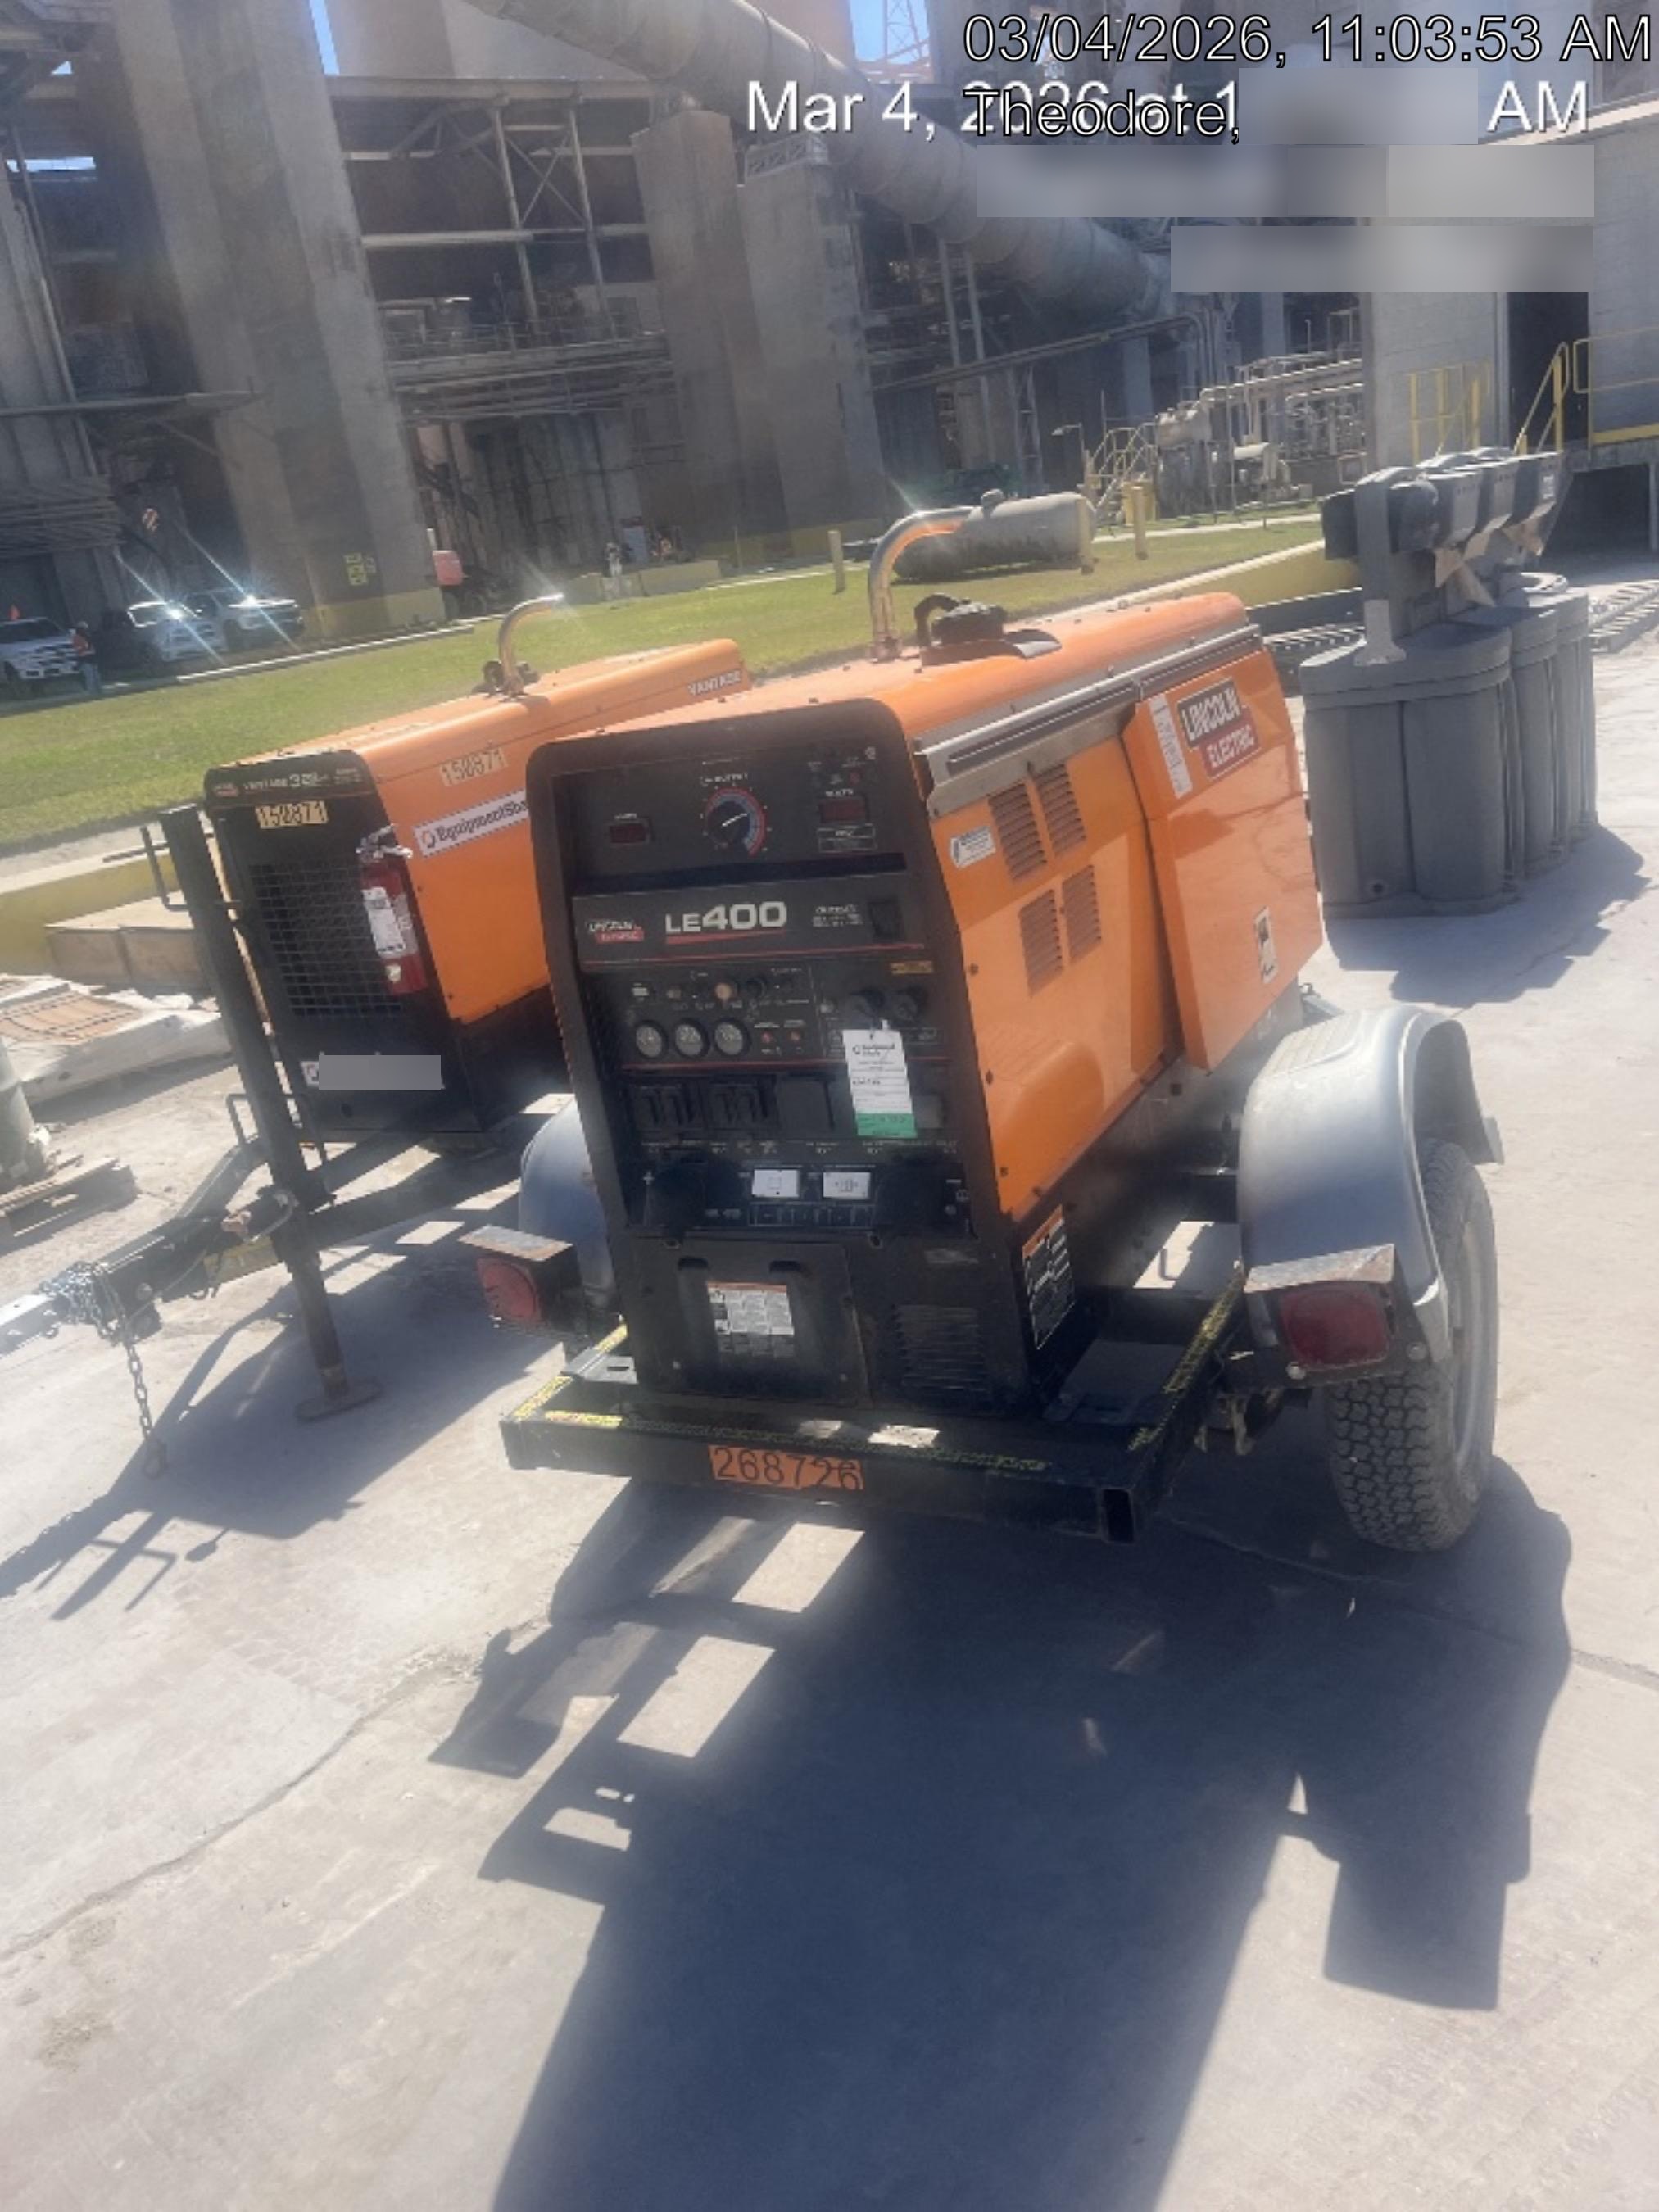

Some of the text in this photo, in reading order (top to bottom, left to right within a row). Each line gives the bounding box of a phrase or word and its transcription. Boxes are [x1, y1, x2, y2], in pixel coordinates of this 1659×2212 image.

[1181, 687, 1241, 741] LINCOLN
[1206, 724, 1255, 768] ELECTRIC
[666, 901, 787, 934] LE400
[714, 1446, 863, 1489] 268726
